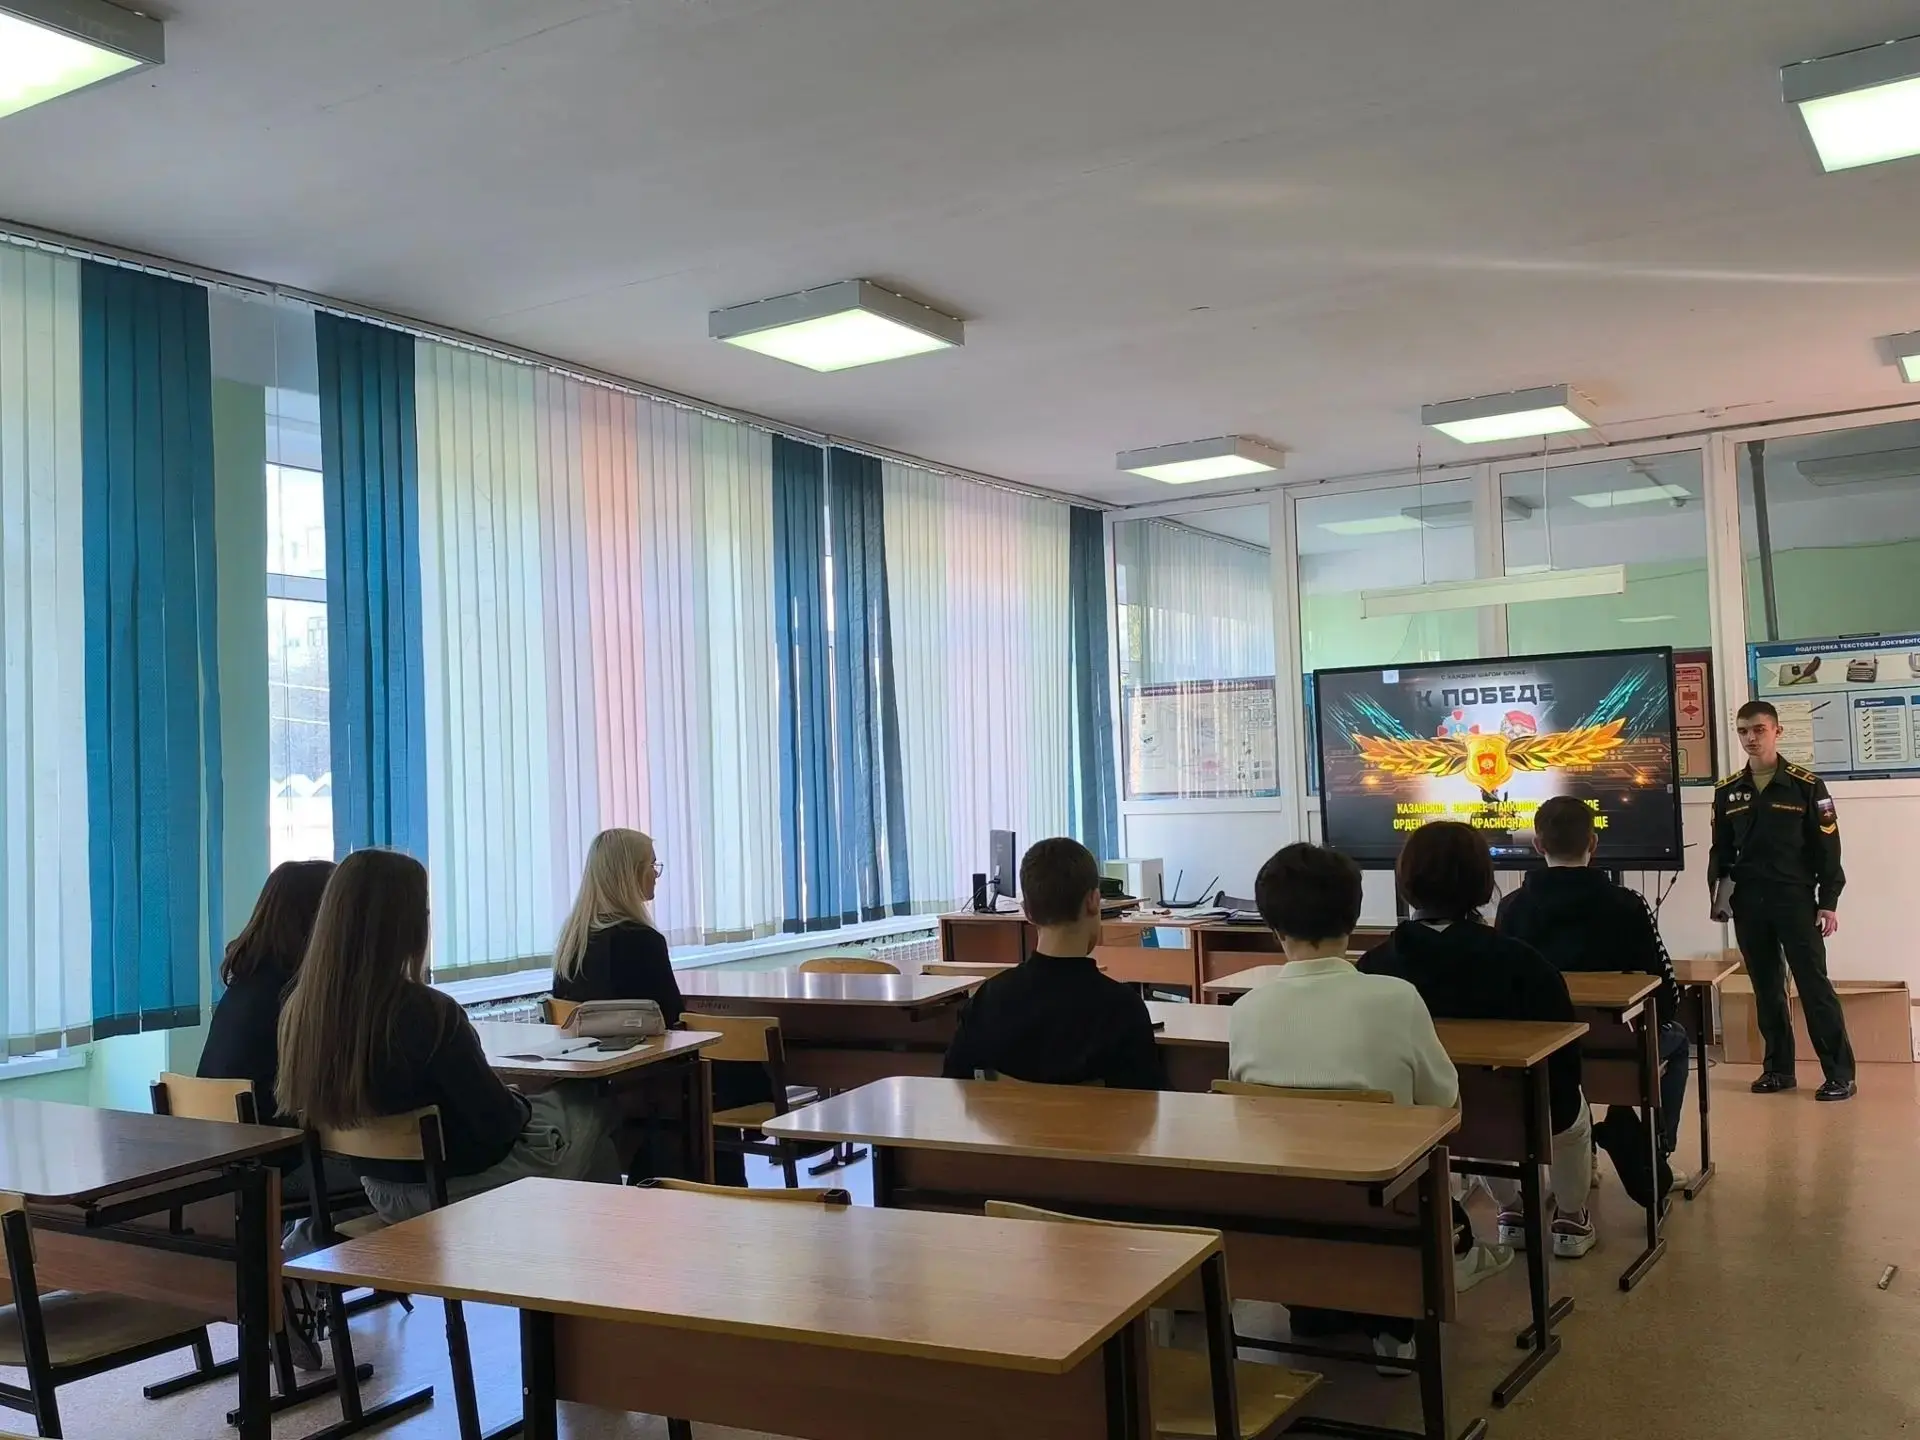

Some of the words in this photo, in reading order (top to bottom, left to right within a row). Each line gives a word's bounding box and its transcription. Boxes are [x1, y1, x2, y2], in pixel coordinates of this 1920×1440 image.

[1795, 644, 1838, 653] ПОДГОТОВКА
[1840, 641, 1880, 649] ТЕКСТОВЫХ
[1503, 669, 1526, 677] БЛИЖЕ
[1415, 690, 1432, 708] К
[1442, 683, 1555, 707] ПОБЕДЕ
[1397, 802, 1446, 815] КАЗАНСКОЕ
